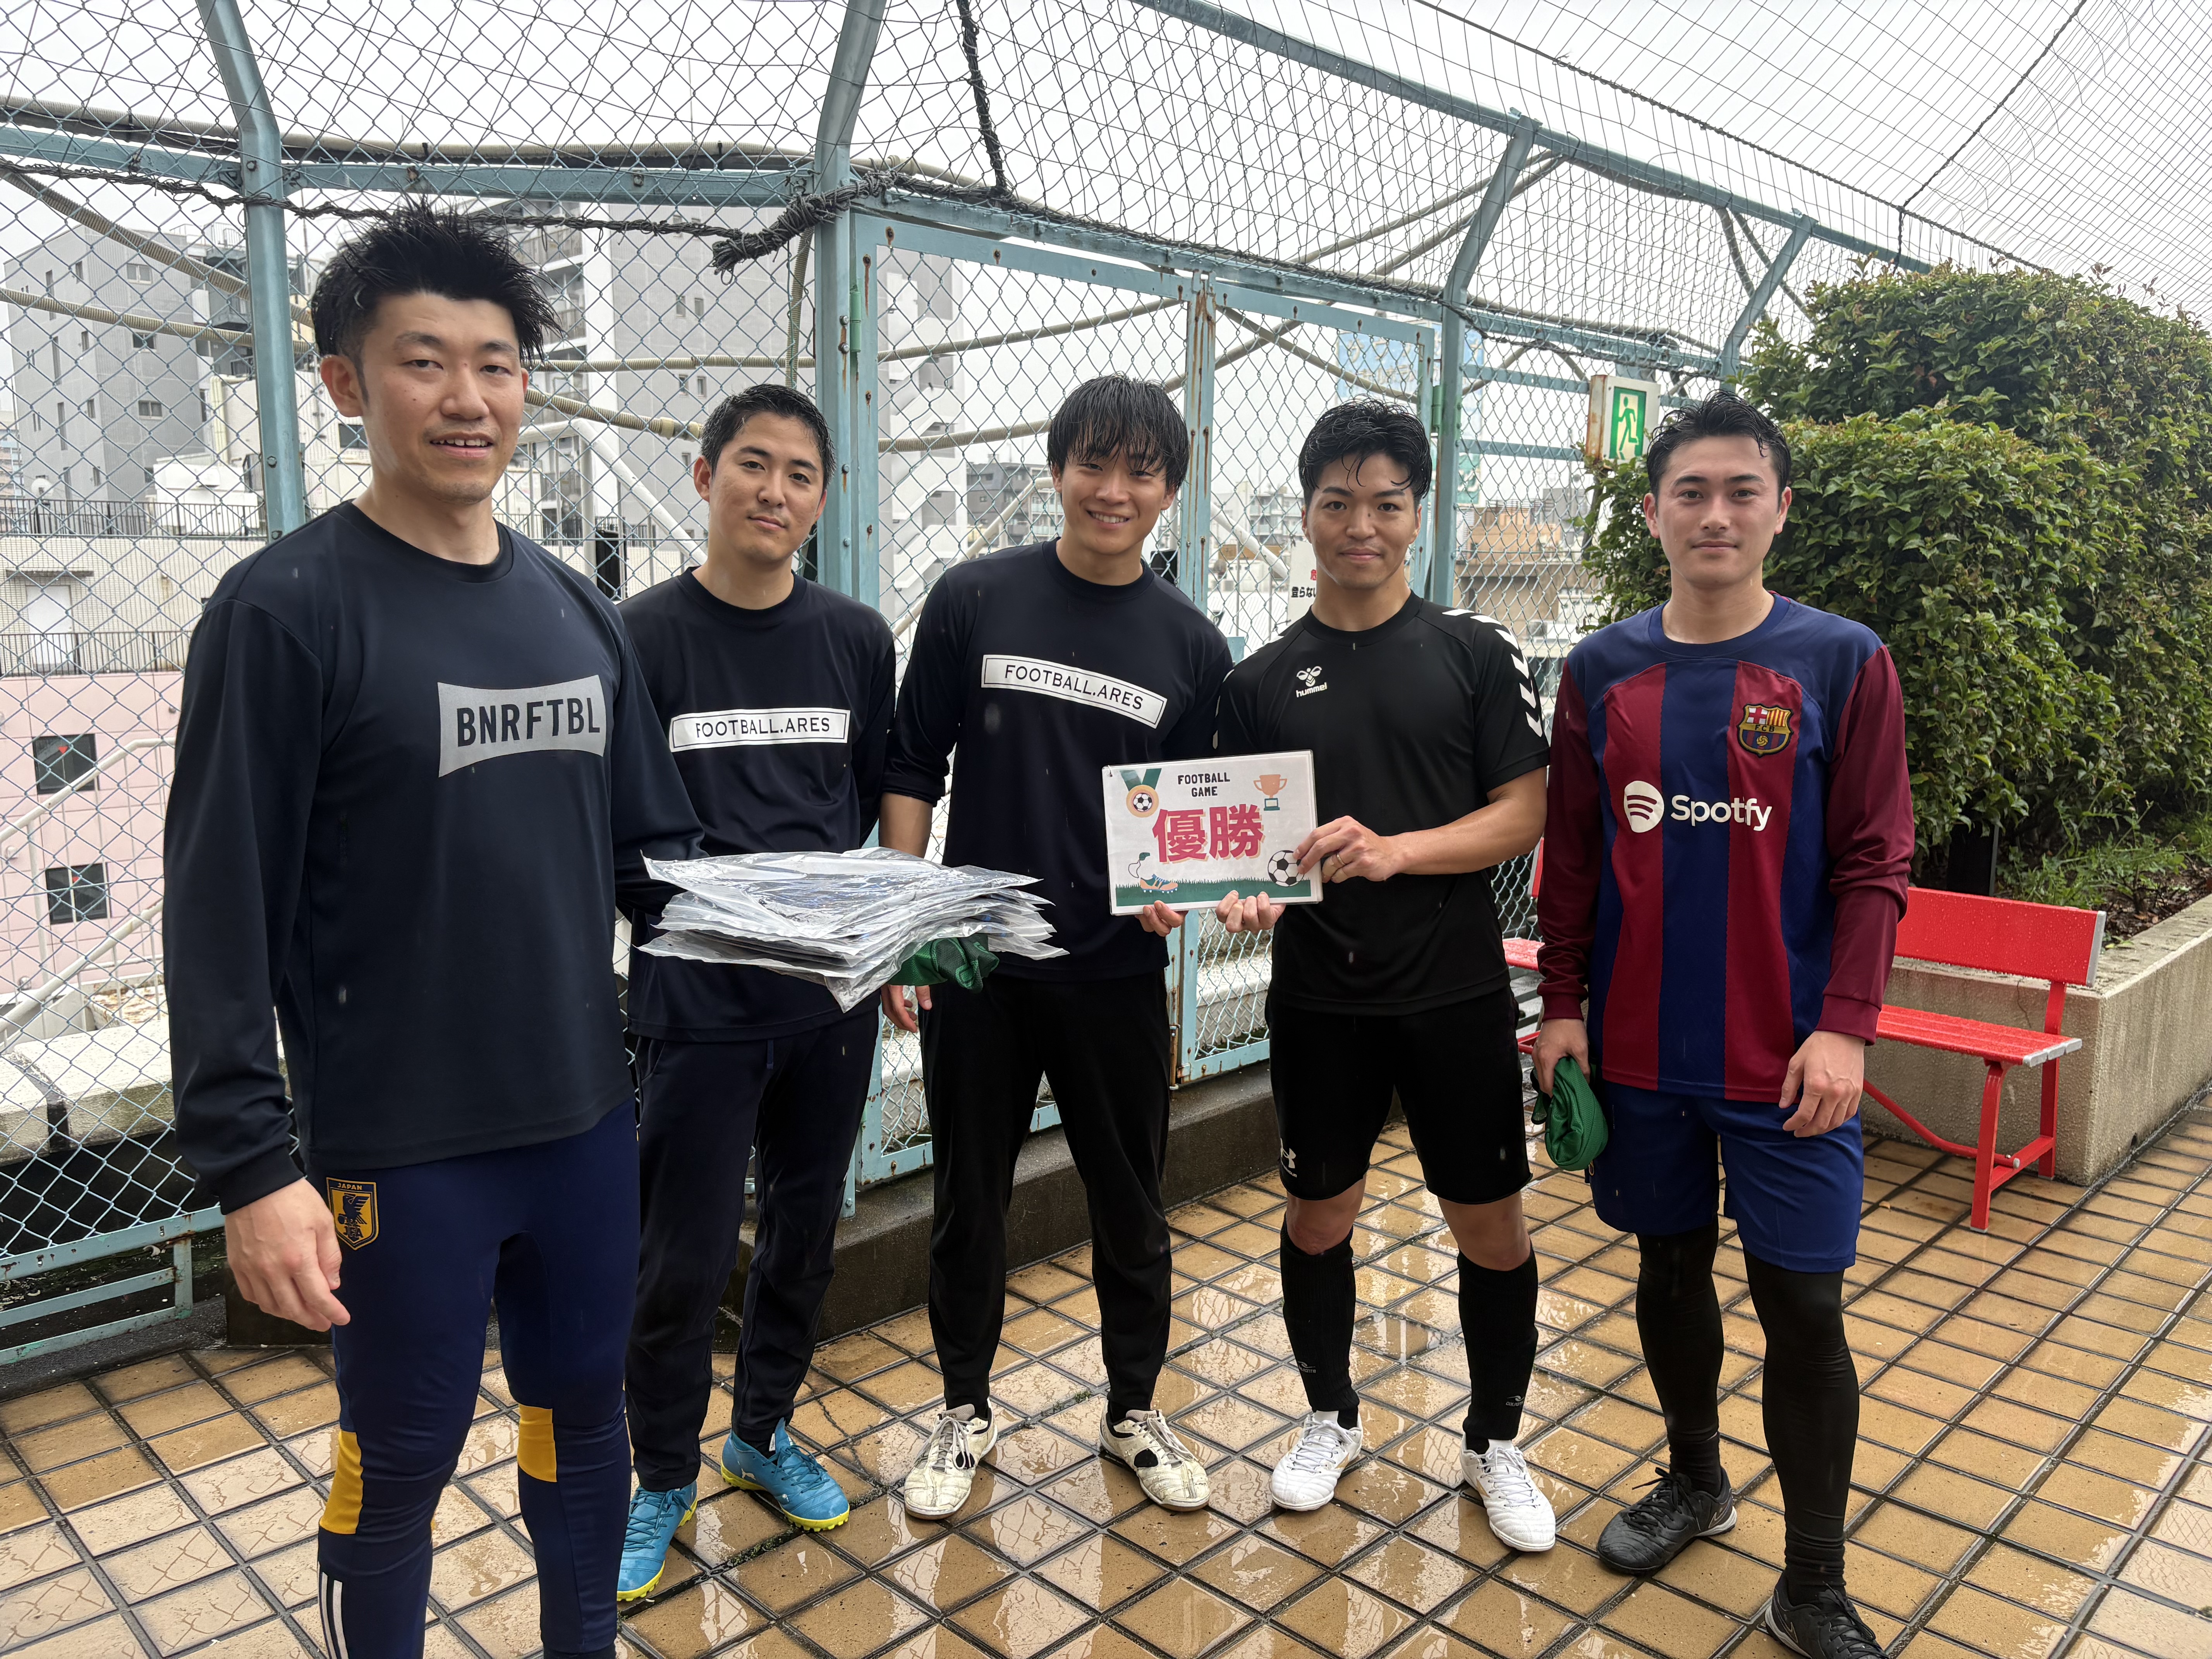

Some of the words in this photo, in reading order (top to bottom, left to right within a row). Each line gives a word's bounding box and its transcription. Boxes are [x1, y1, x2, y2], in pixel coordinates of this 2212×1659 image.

[1005, 665, 1143, 709] FOOTBALL.ARES
[1296, 682, 1327, 697] hummel
[457, 697, 600, 747] BNRFTBL
[696, 718, 830, 738] FOOTBALL.ARES
[1178, 772, 1230, 785] FOOTBALL
[1191, 786, 1218, 797] GAME
[1671, 795, 1772, 831] Spotfy
[1152, 804, 1264, 863] 優勝
[343, 1226, 364, 1238] JFA
